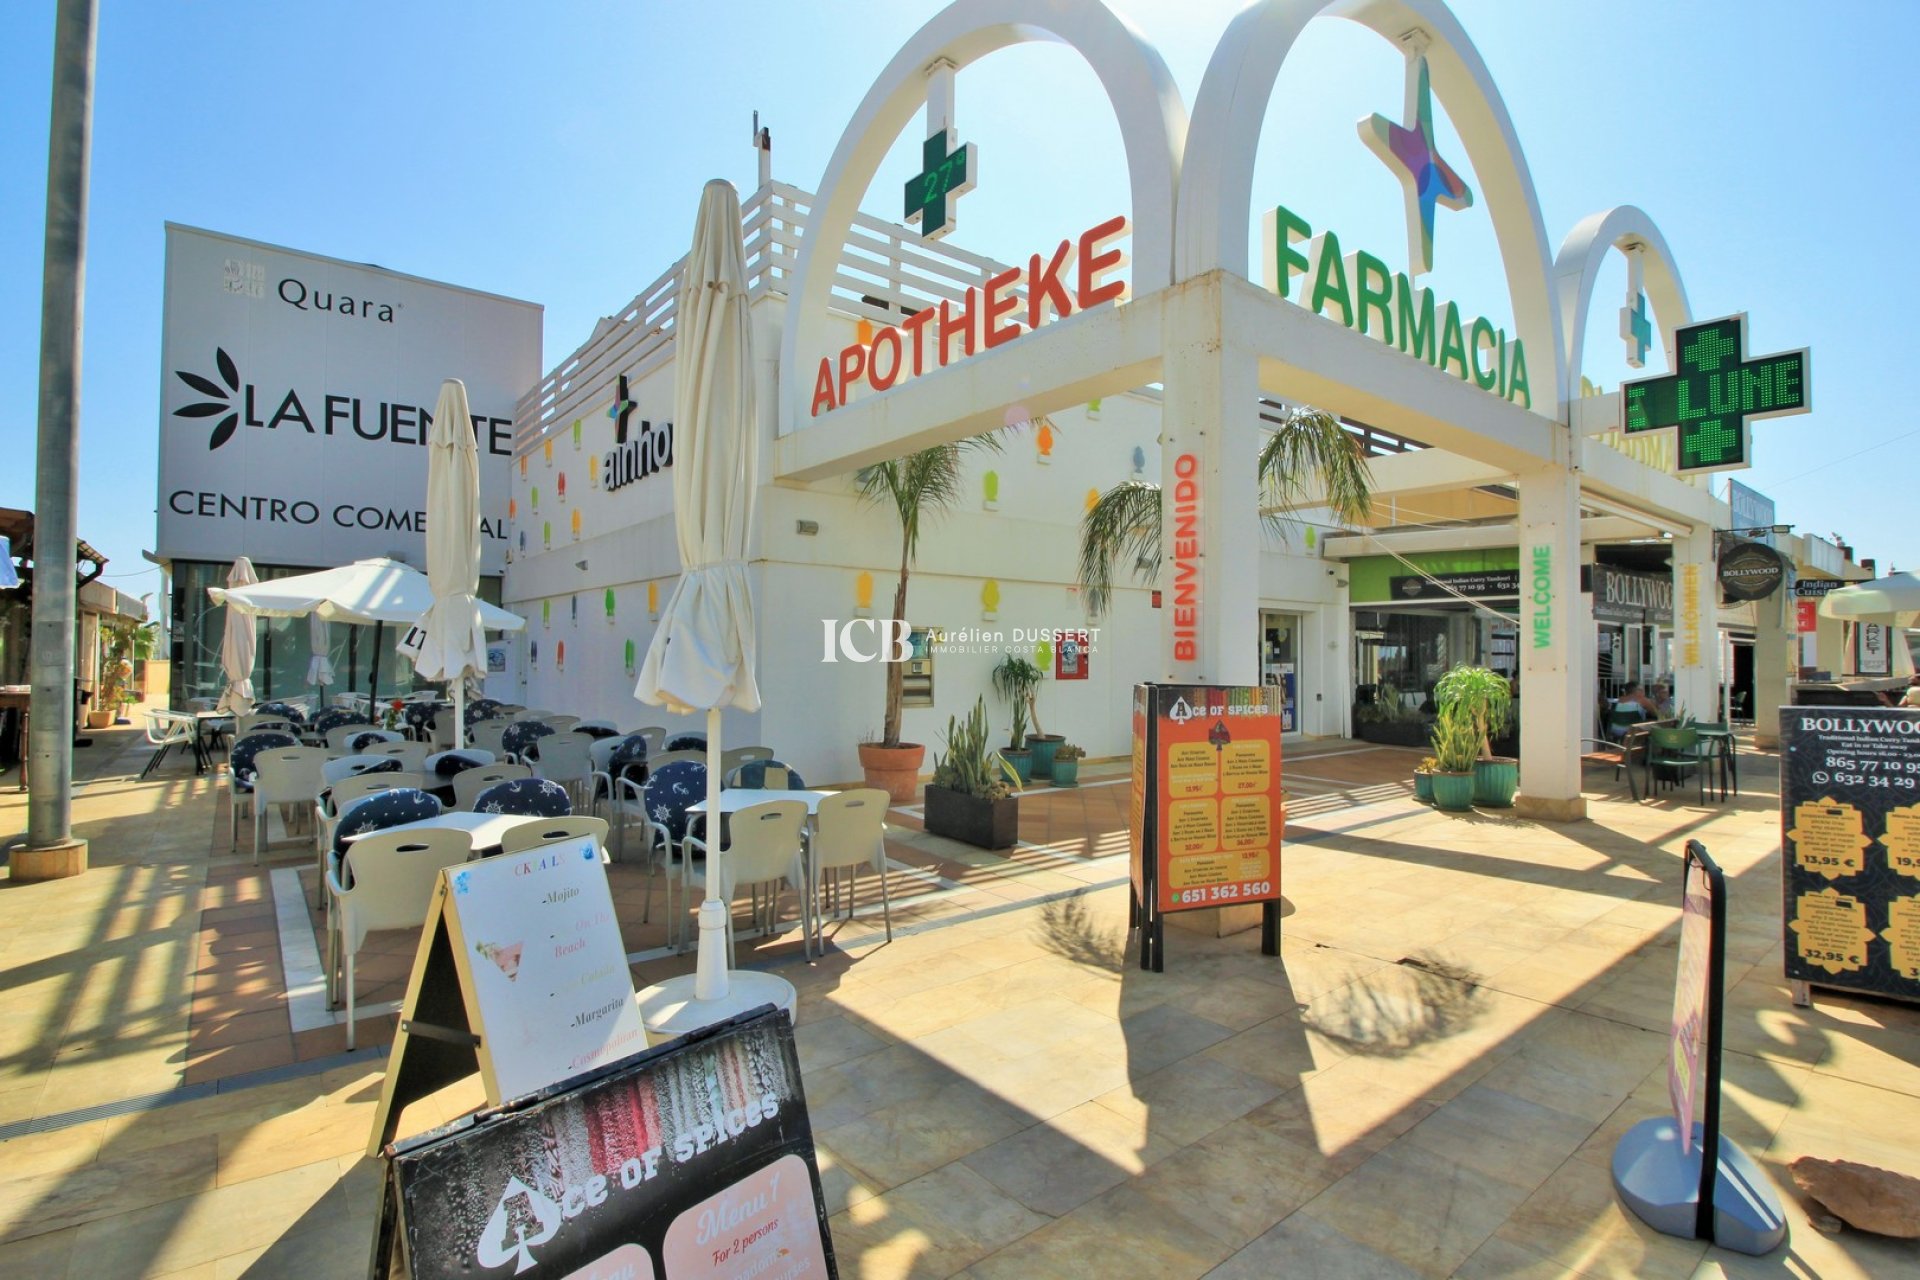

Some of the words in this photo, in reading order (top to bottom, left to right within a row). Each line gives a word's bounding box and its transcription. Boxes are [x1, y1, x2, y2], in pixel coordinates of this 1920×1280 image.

[811, 215, 1130, 417] APOTHEKE
[1271, 205, 1531, 410] FARMACIA
[245, 383, 316, 434] LA
[1678, 359, 1799, 420] LUNE
[169, 489, 320, 525] CENTRO
[333, 504, 508, 540] COMEAL
[1174, 454, 1198, 661] BIENVENIDO
[1722, 568, 1779, 577] BOLLYWOOD
[1532, 545, 1551, 649] WELCOME
[1803, 580, 1837, 588] Indian
[1825, 756, 1856, 770] 865
[1860, 761, 1879, 771] 77
[1883, 762, 1901, 770] 10
[1834, 772, 1864, 785] 632
[1868, 776, 1889, 787] 34
[1894, 777, 1915, 788] 29
[1844, 858, 1854, 867] €
[1182, 888, 1206, 903] 651
[1211, 885, 1238, 900] 362
[1243, 881, 1270, 896] 560
[1805, 948, 1843, 962] 32,95
[1848, 955, 1860, 964] €
[696, 1195, 769, 1245] Menu
[712, 1247, 731, 1268] For
[733, 1238, 740, 1255] 2
[742, 1218, 779, 1254] persons
